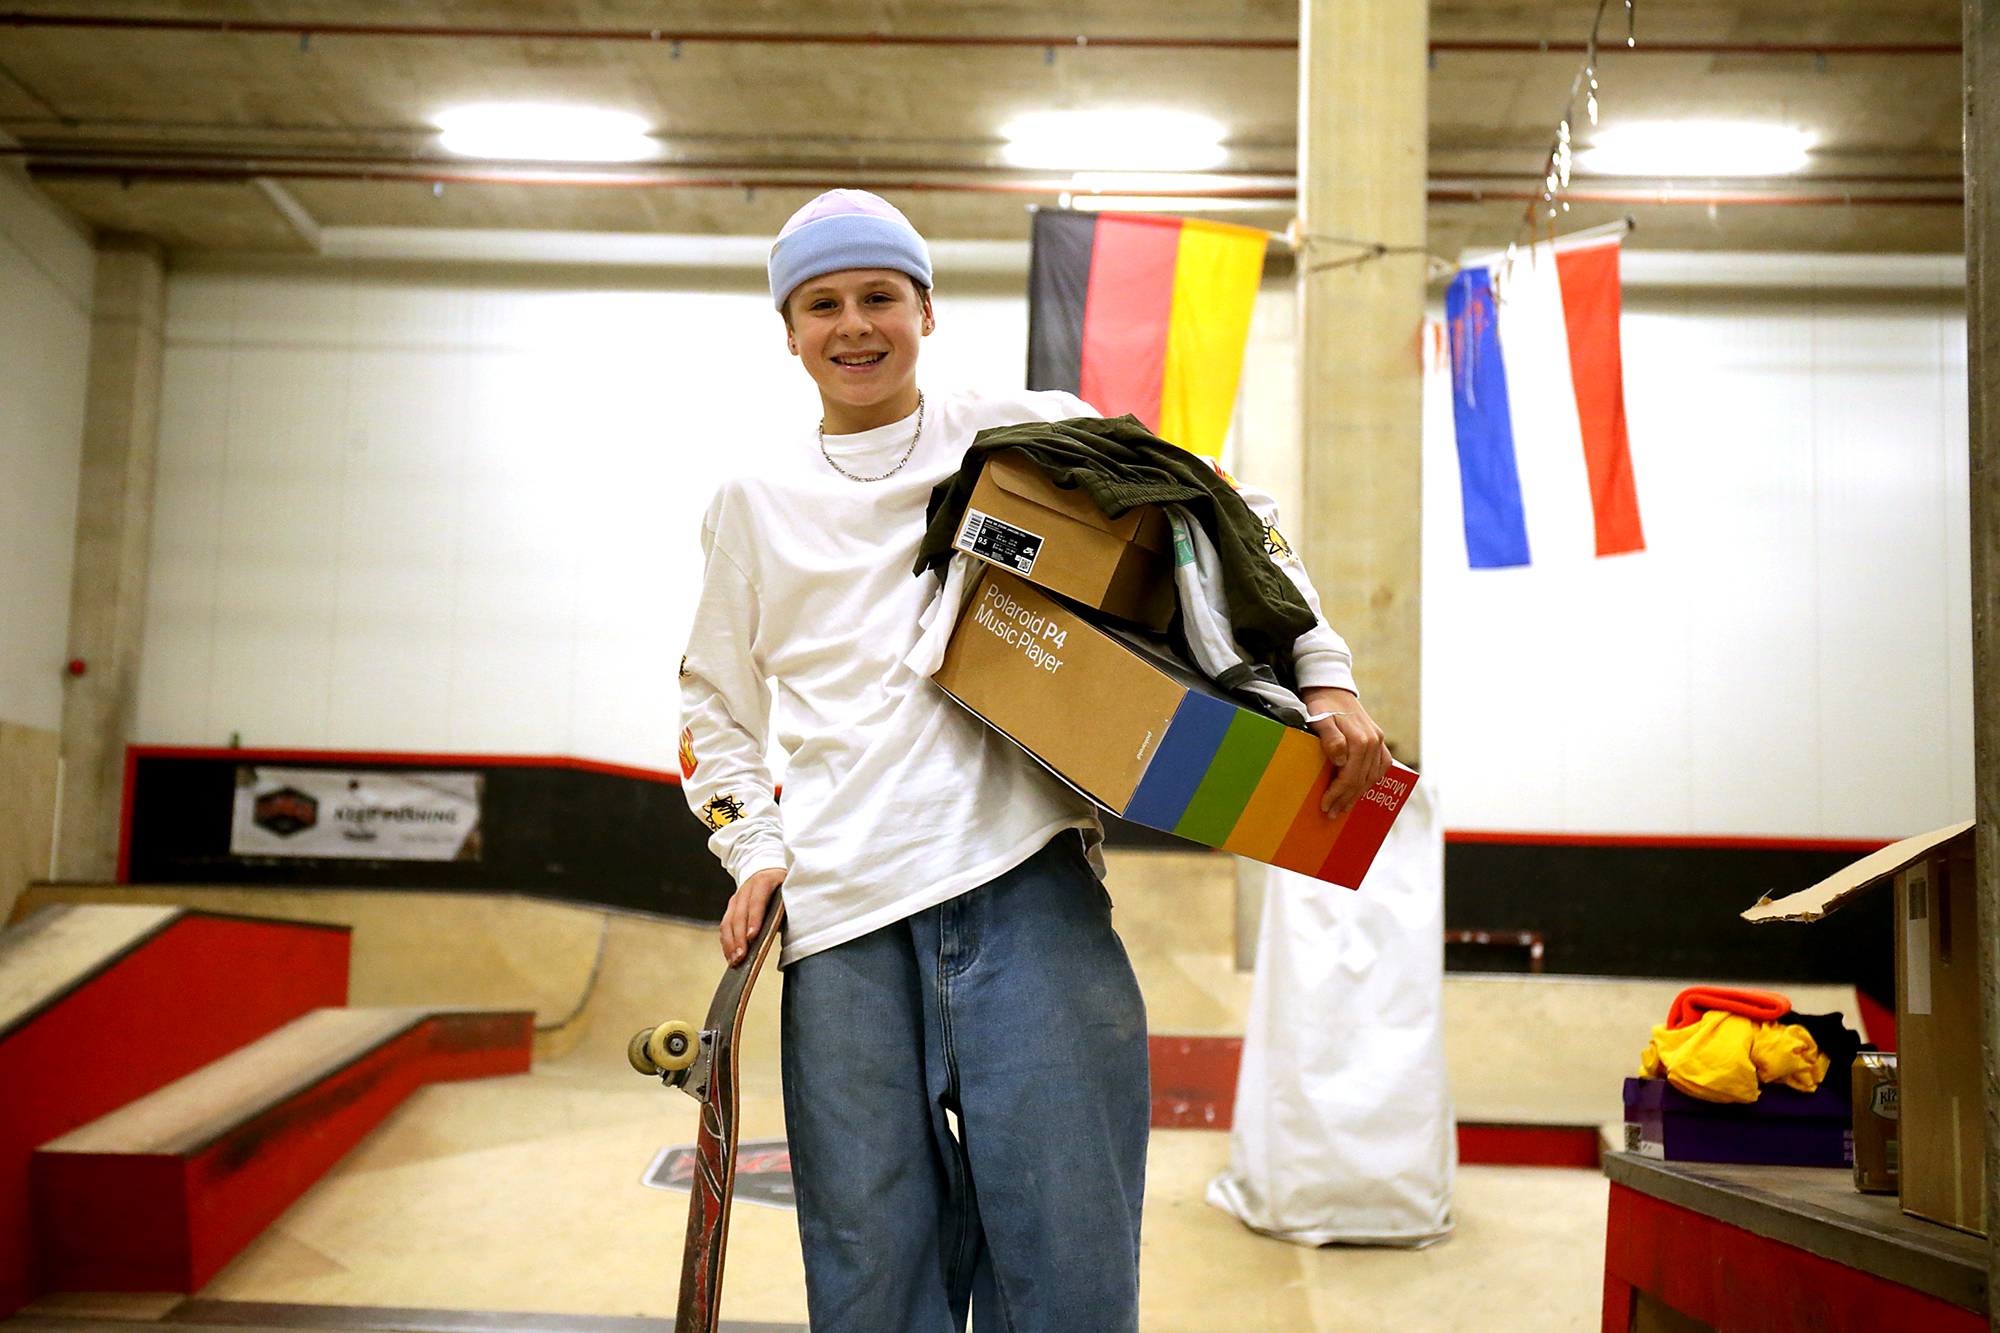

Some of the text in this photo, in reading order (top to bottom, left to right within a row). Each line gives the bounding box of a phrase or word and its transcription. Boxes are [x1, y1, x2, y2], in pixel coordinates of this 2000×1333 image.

[978, 536, 988, 546] 9.5
[984, 583, 1068, 650] Polaroid P4
[974, 603, 1064, 674] Music Player
[1136, 730, 1152, 760] polaroid
[1361, 789, 1400, 811] Polaroi
